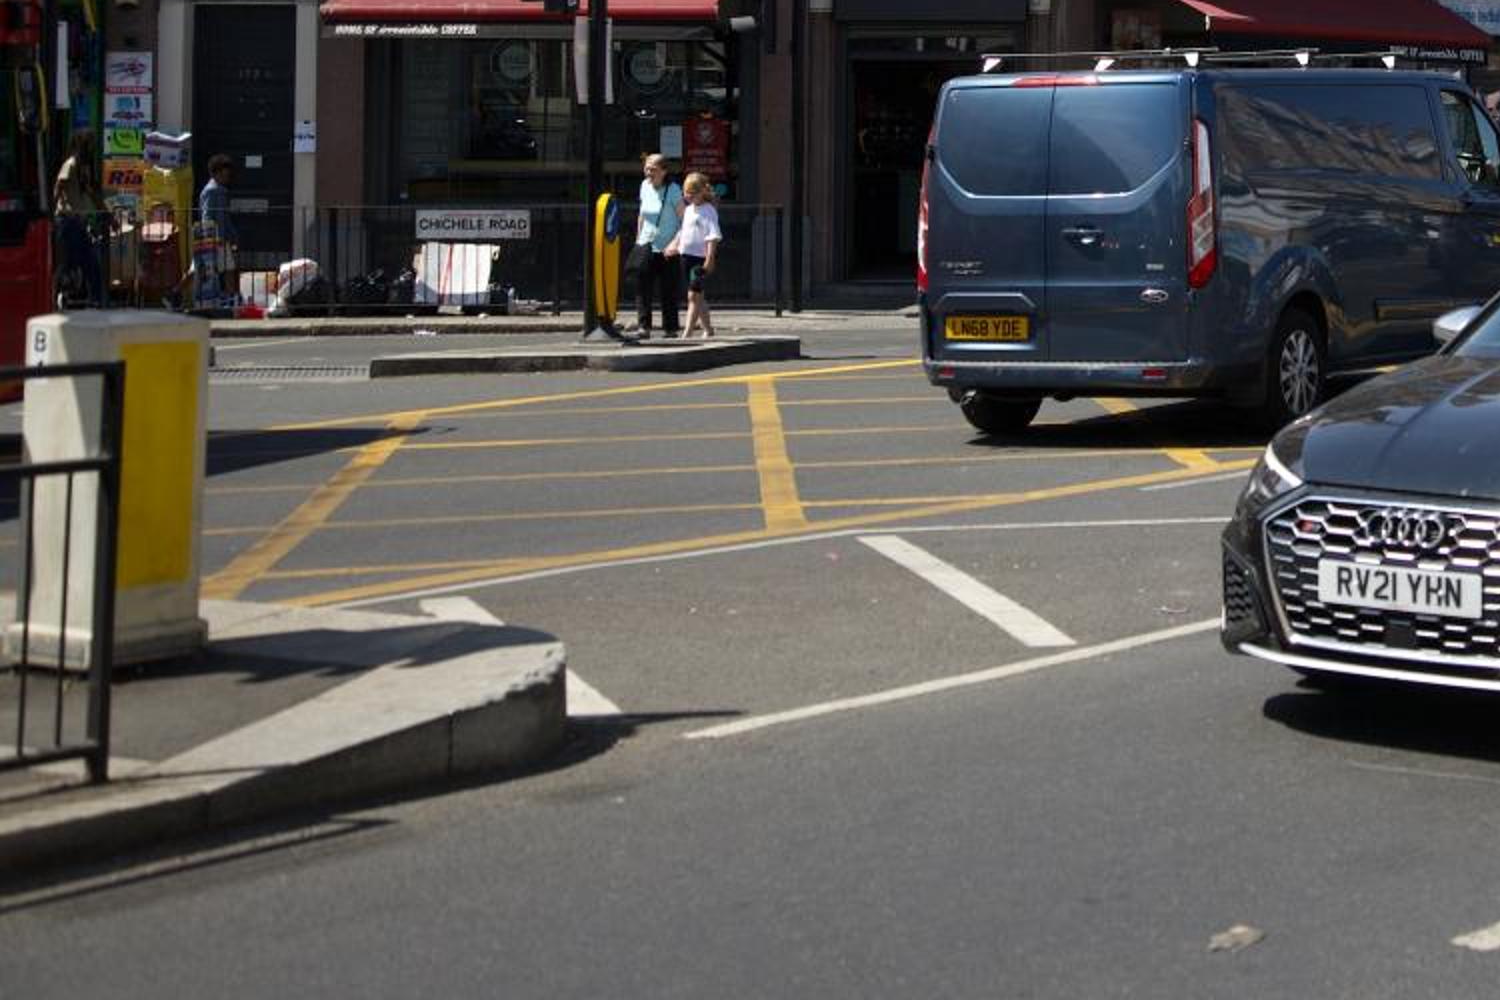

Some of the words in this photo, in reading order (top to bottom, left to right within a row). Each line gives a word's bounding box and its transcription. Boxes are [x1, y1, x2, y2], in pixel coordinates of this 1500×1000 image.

[419, 218, 484, 231] CHICHELE
[489, 218, 528, 231] ROAD
[992, 318, 1021, 337] YDE
[1337, 566, 1398, 601] RV21
[1407, 572, 1462, 609] YHN
